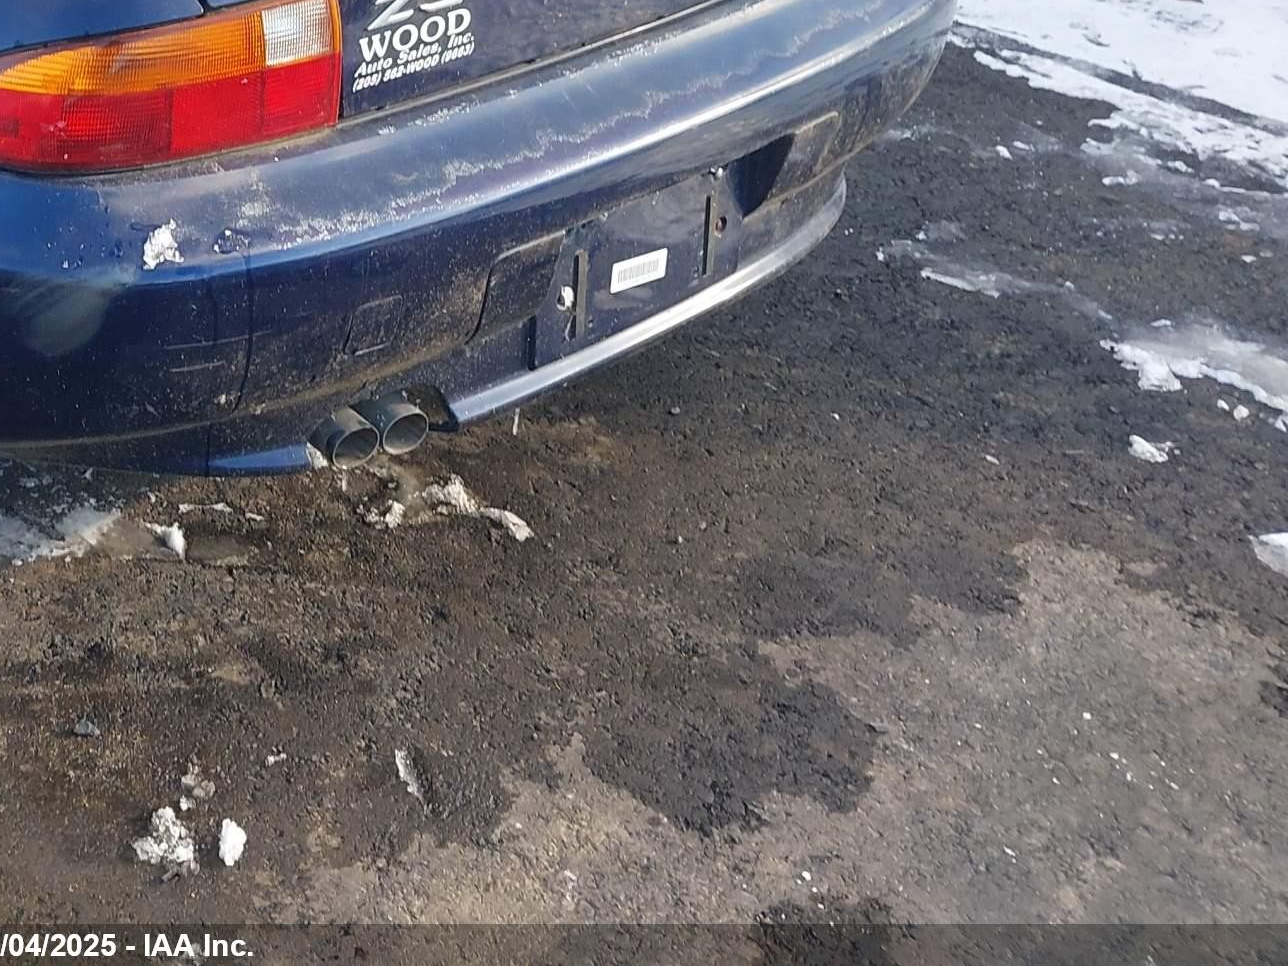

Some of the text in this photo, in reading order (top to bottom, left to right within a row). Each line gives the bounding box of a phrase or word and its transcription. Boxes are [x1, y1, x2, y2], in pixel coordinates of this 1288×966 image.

[354, 32, 475, 78] Auto Sales, Inc.
[359, 8, 472, 62] WOOD
